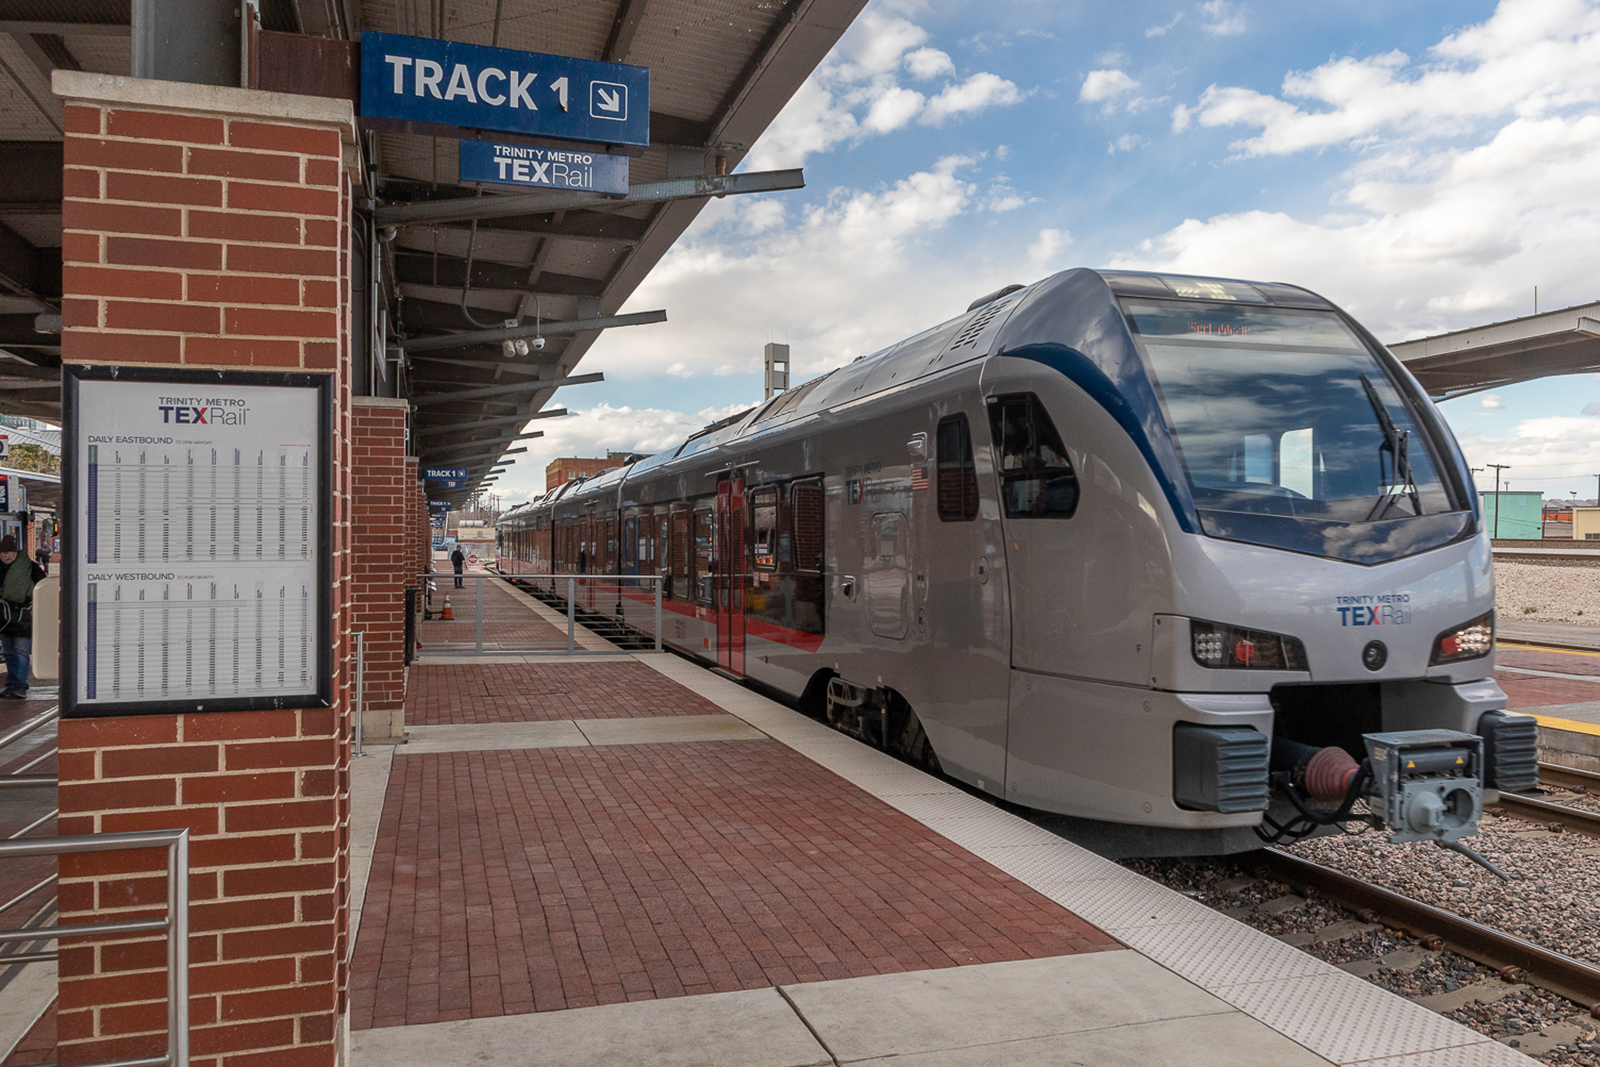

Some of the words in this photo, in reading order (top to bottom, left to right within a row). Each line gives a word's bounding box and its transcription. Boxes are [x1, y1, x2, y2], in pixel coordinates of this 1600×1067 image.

[384, 54, 539, 111] TRACK
[549, 76, 569, 113] 1
[493, 145, 544, 160] TRINITY
[547, 151, 593, 165] METRO
[493, 156, 593, 188] TEXRail
[158, 396, 203, 406] TRINITY
[205, 398, 246, 407] METRO
[158, 406, 248, 426] TEXRail
[88, 435, 114, 443] DAILY
[116, 436, 174, 445] EASTBOUND
[427, 470, 451, 478] TRACK
[87, 573, 114, 581] DAILY
[115, 572, 175, 581] WESTBOUND
[1335, 595, 1375, 605] TRINITY
[1377, 594, 1411, 604] METRO
[1336, 605, 1412, 627] TEXRail
